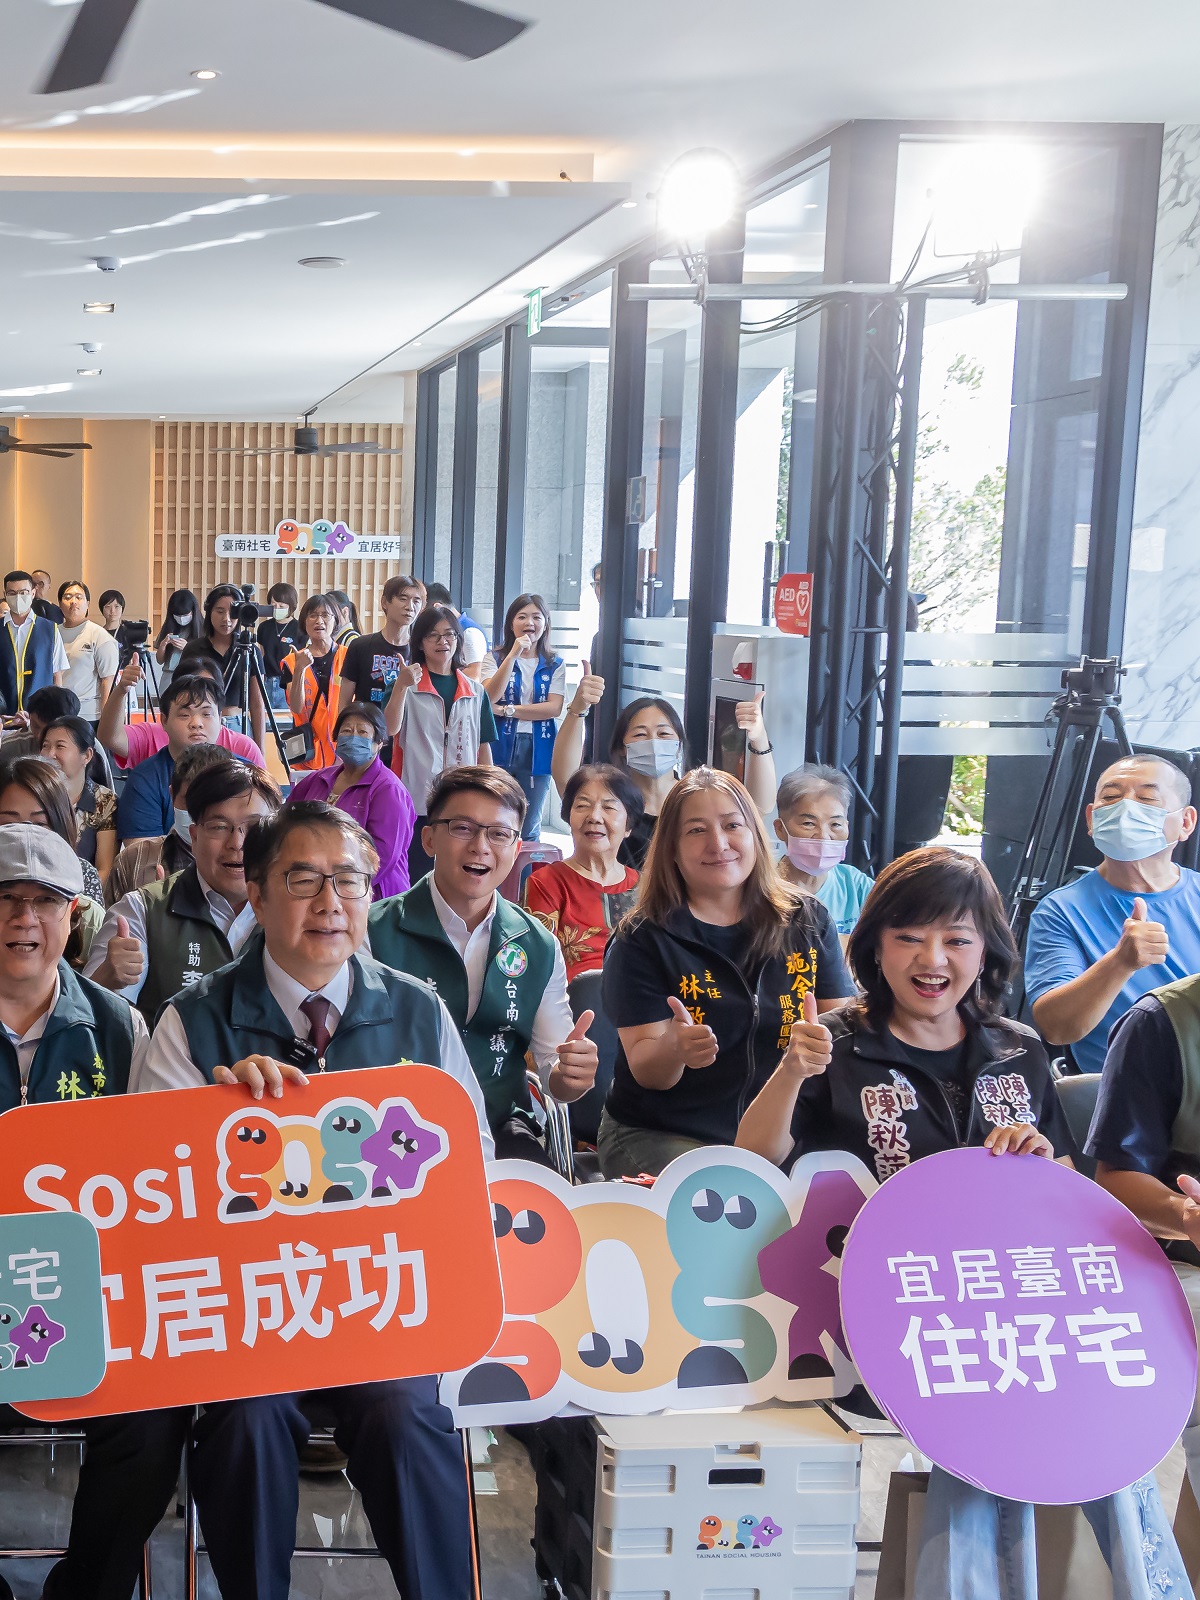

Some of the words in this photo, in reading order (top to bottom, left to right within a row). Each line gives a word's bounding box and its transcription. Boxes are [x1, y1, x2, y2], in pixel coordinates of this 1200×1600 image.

[222, 539, 271, 552] 臺南社宅
[779, 588, 795, 602] AED
[704, 969, 722, 999] 主任
[56, 1070, 87, 1100] 林
[23, 1143, 198, 1230] Sosi
[887, 1242, 1125, 1304] 宜居臺南
[899, 1305, 1156, 1398] 住好宅
